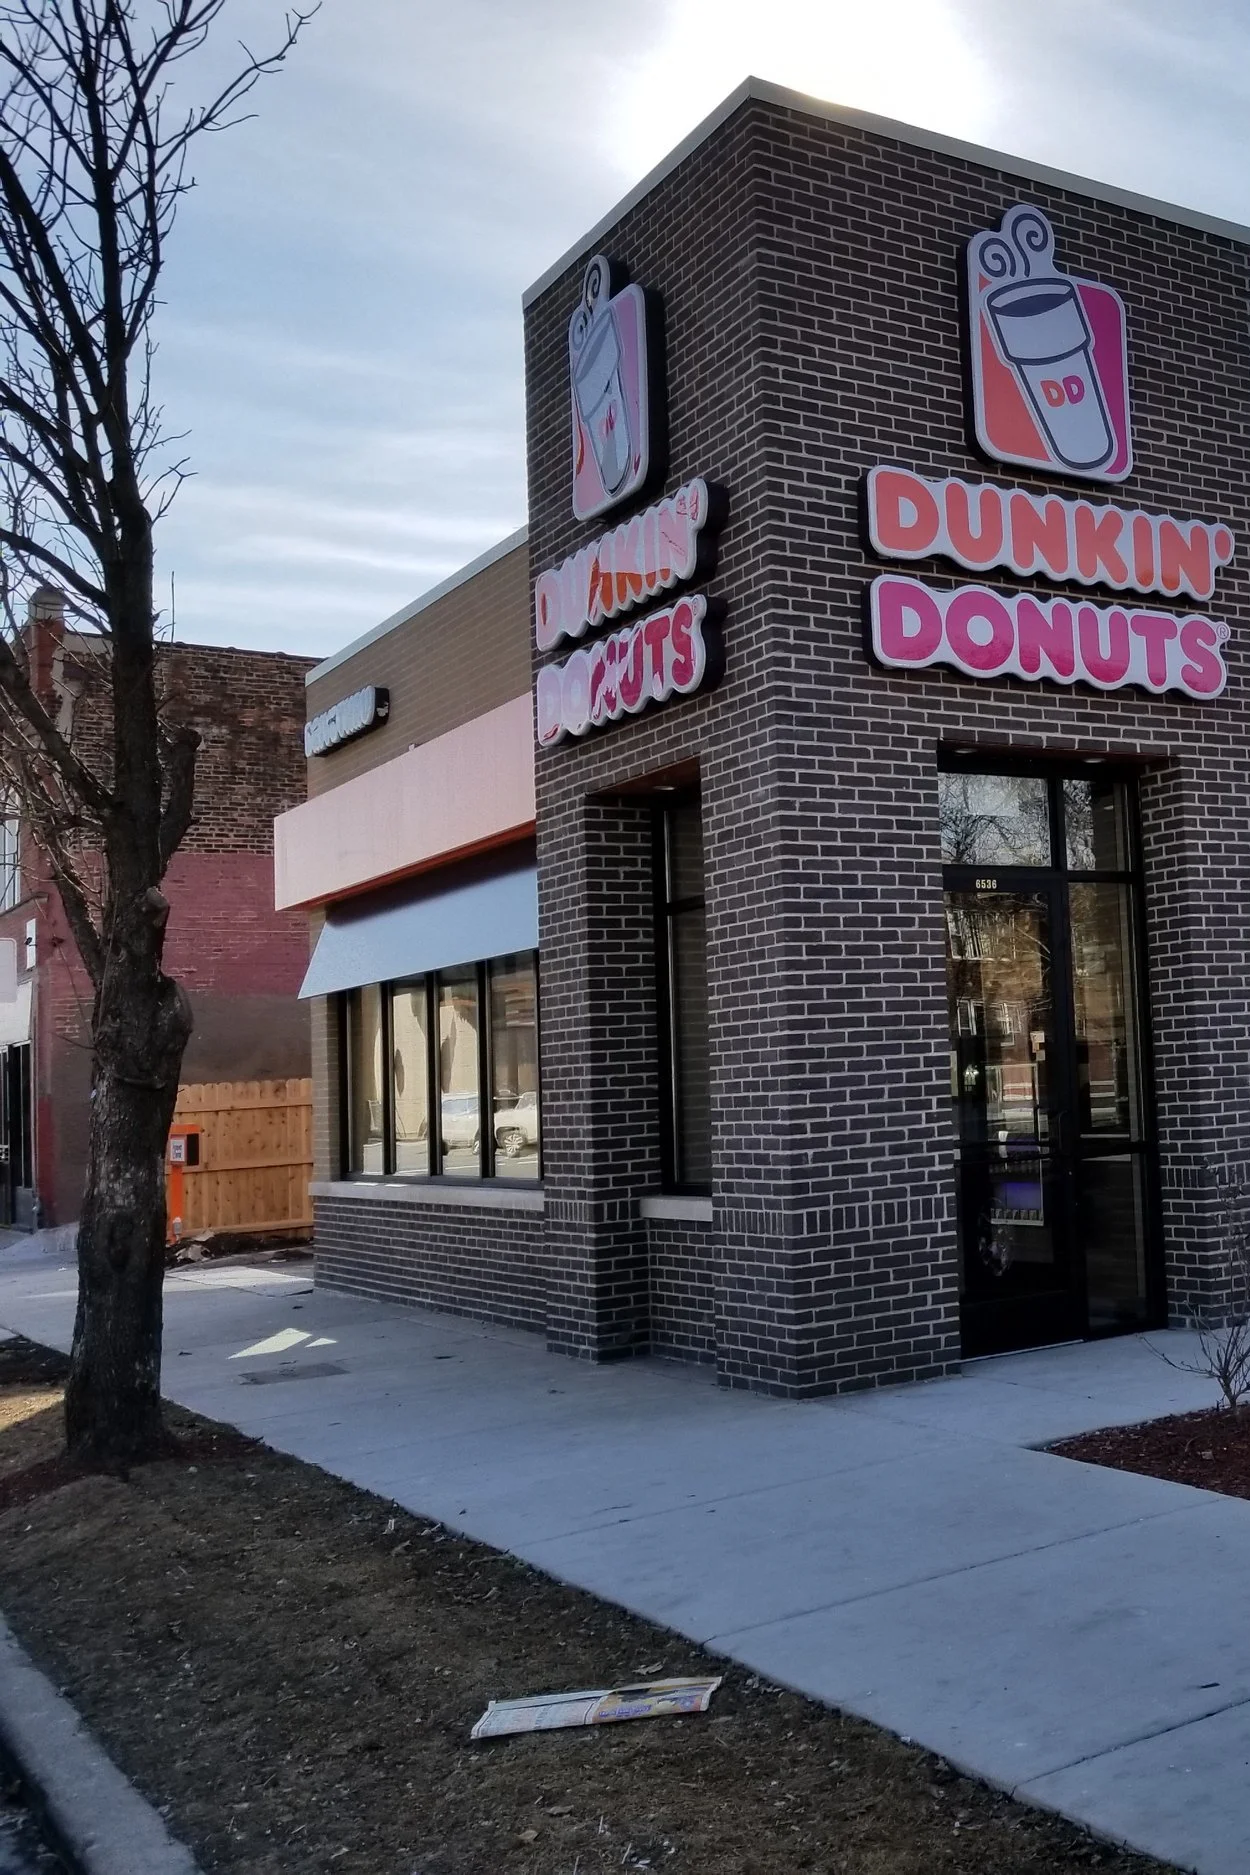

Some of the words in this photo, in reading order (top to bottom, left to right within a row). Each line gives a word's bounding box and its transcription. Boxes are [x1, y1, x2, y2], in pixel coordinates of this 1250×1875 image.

[1040, 375, 1085, 408] DD
[875, 470, 1231, 596] DUNKIN'
[878, 580, 1223, 693] DONUTS
[975, 879, 998, 889] 6536
